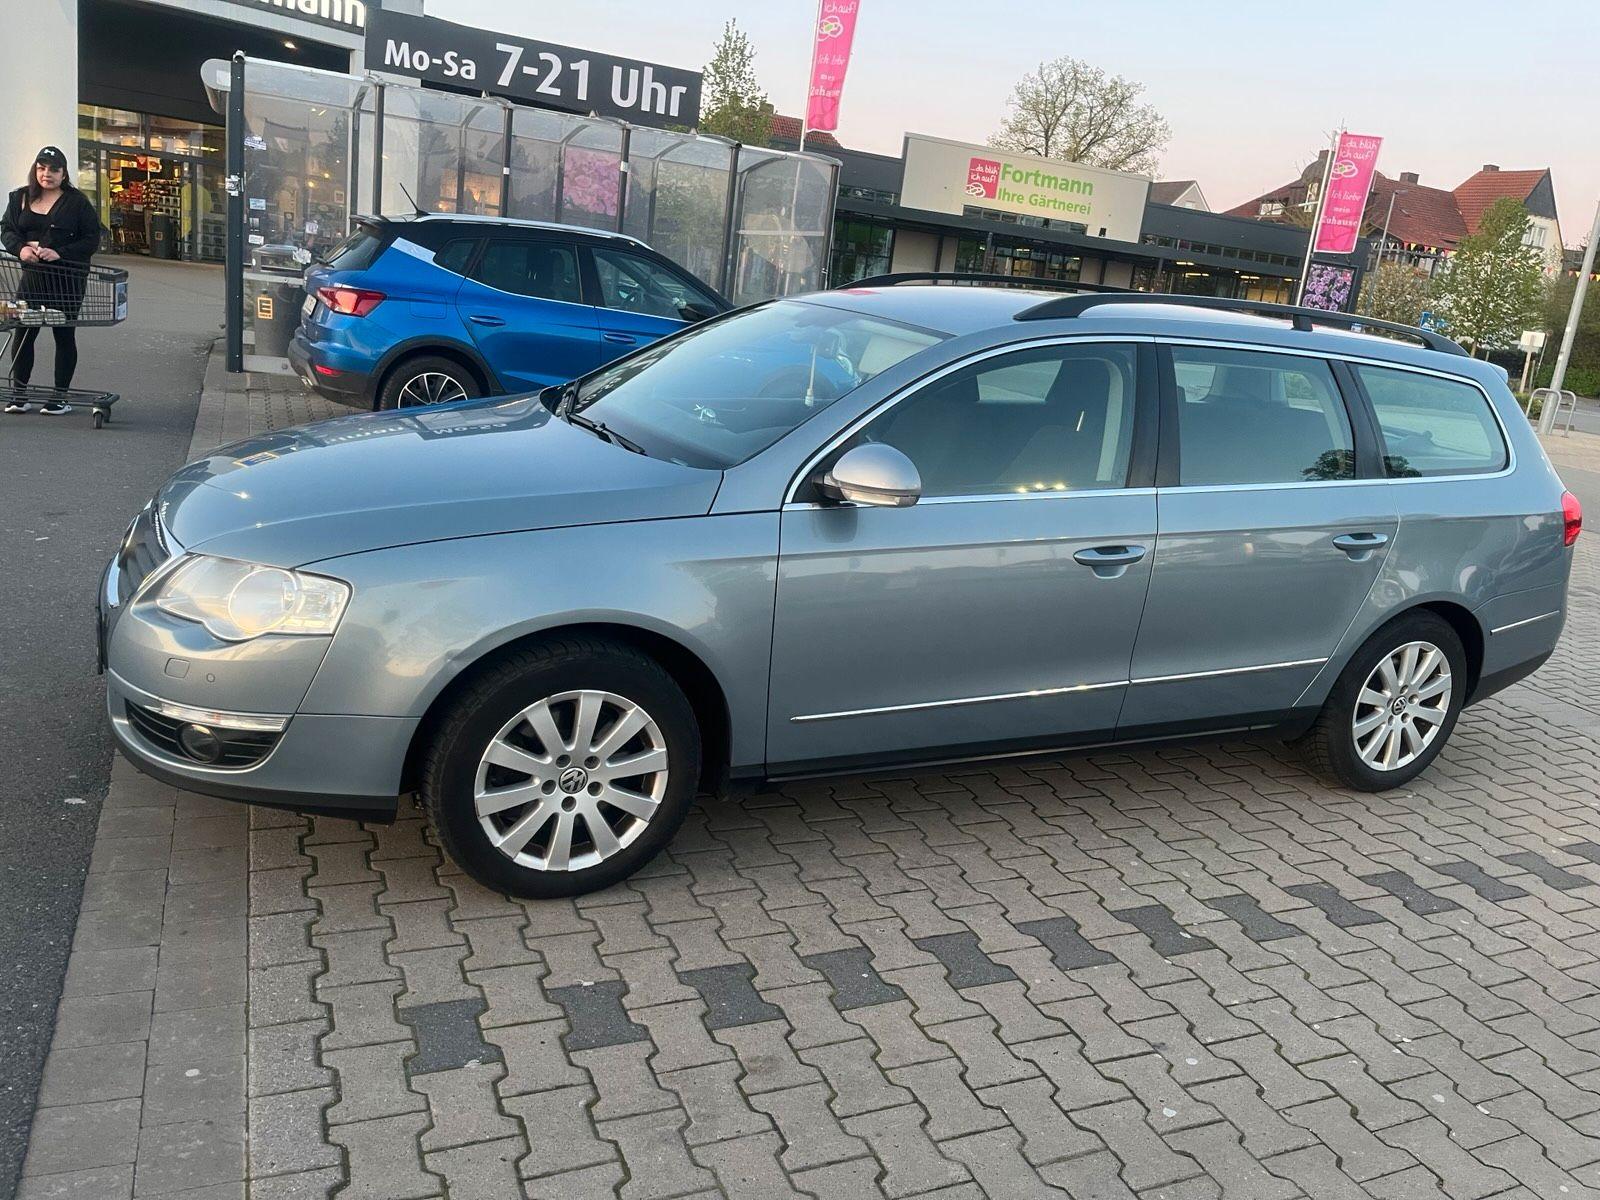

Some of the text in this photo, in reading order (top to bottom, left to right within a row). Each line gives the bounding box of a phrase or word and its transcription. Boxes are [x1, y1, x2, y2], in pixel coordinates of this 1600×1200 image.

[384, 39, 688, 117] Mo-Sa 7-21 Uhr
[1001, 163, 1094, 196] Fortmann
[997, 187, 1092, 216] Ihre Gärtnerei
